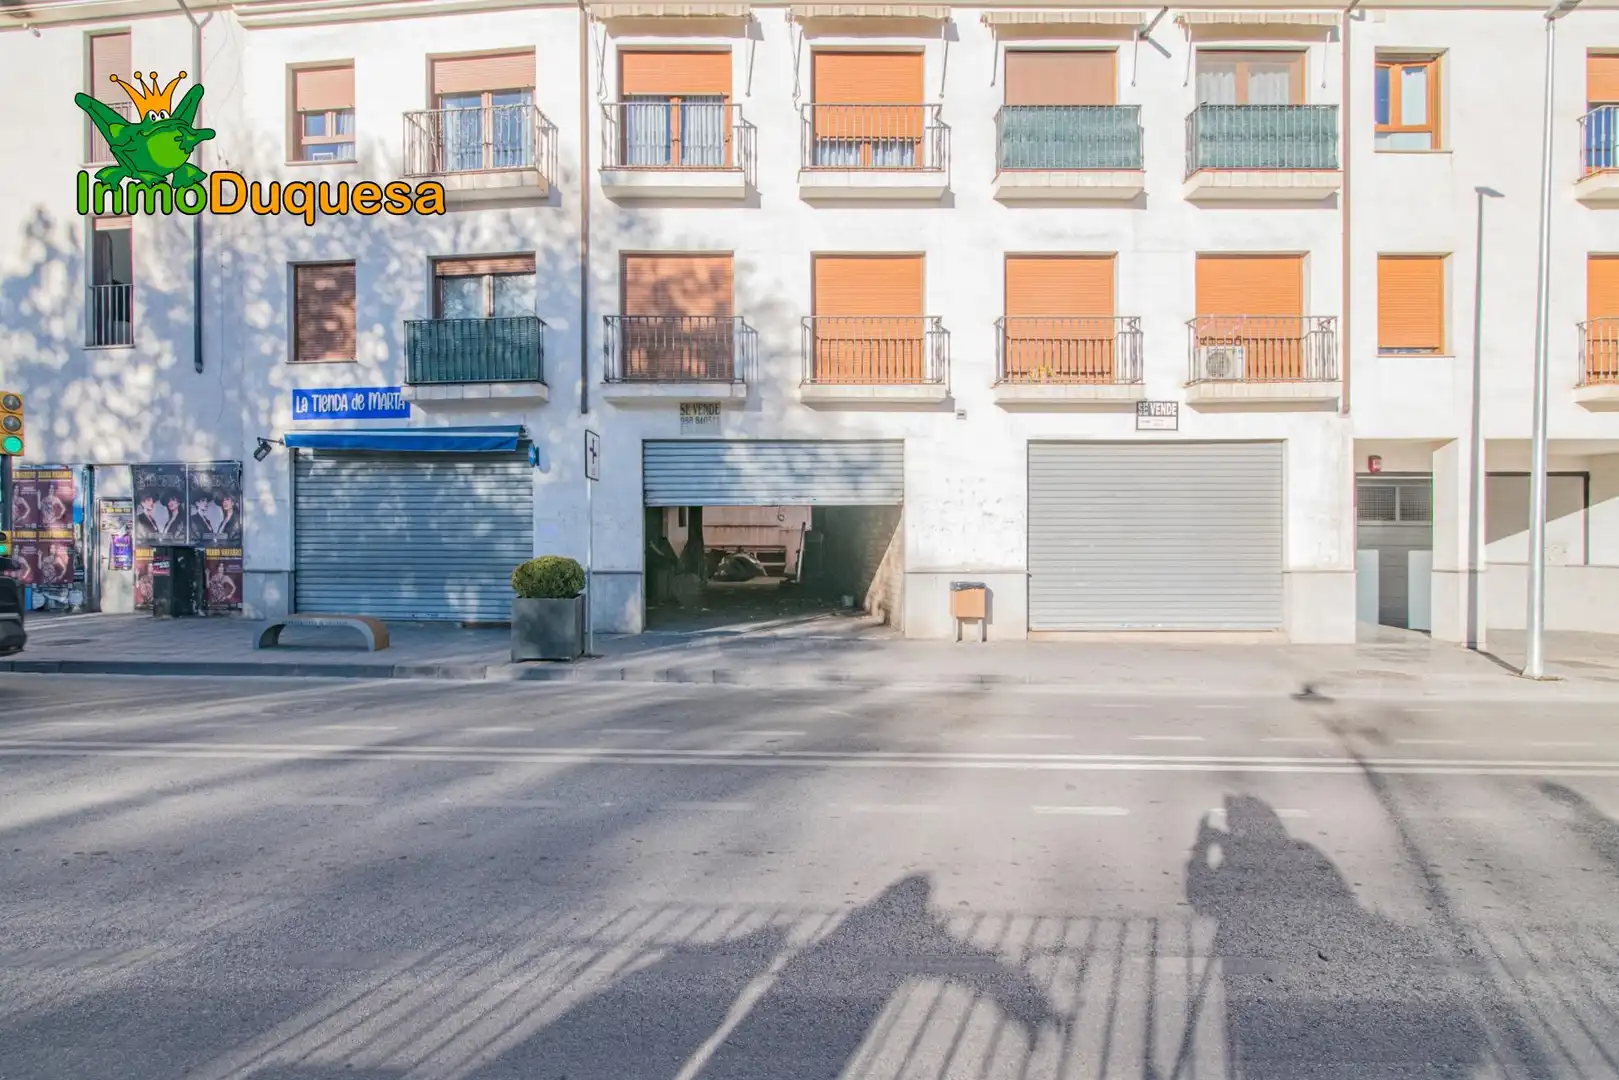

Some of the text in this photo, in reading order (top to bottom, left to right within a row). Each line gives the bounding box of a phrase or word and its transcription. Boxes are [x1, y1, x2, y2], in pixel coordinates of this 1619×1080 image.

[351, 393, 365, 410] de
[680, 401, 720, 415] SE VENDE
[1137, 402, 1177, 415] SE VENDE
